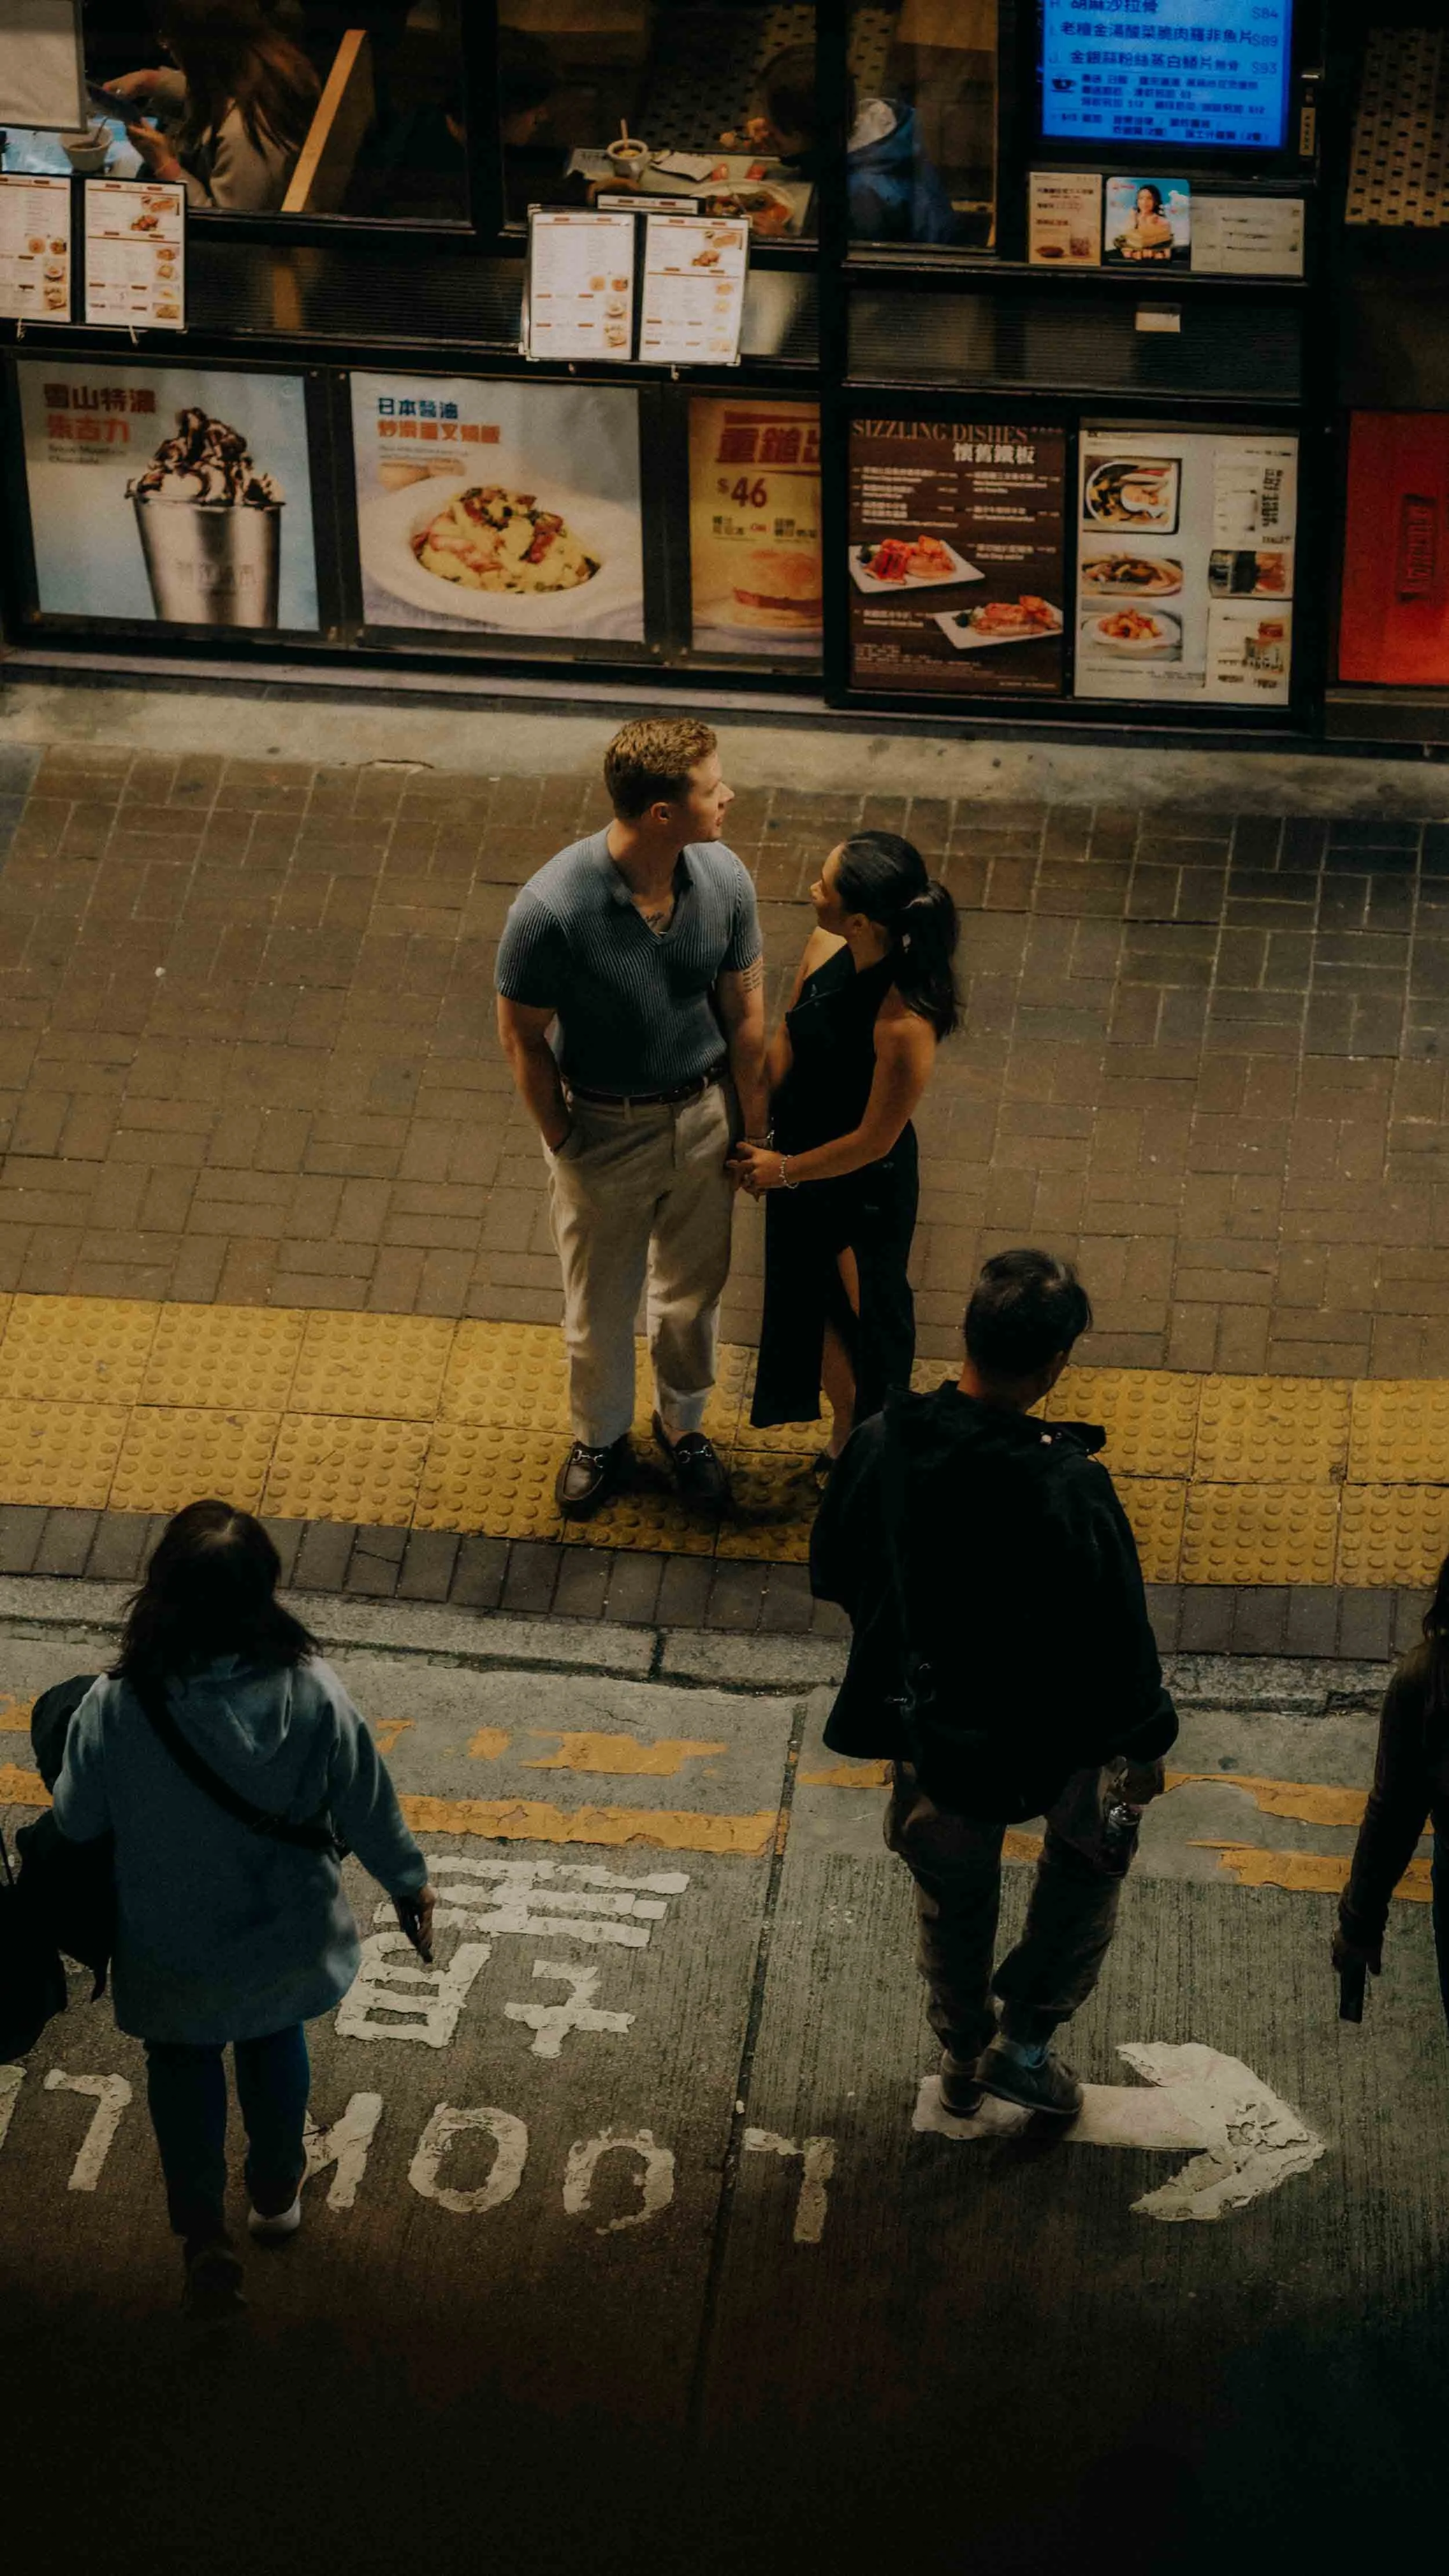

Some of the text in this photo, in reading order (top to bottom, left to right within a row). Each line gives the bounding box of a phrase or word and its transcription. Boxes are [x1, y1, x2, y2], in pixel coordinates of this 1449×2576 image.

[48, 414, 129, 442] 朱古力
[852, 419, 1029, 445] SIZZLING DISHES
[718, 476, 767, 508] $46
